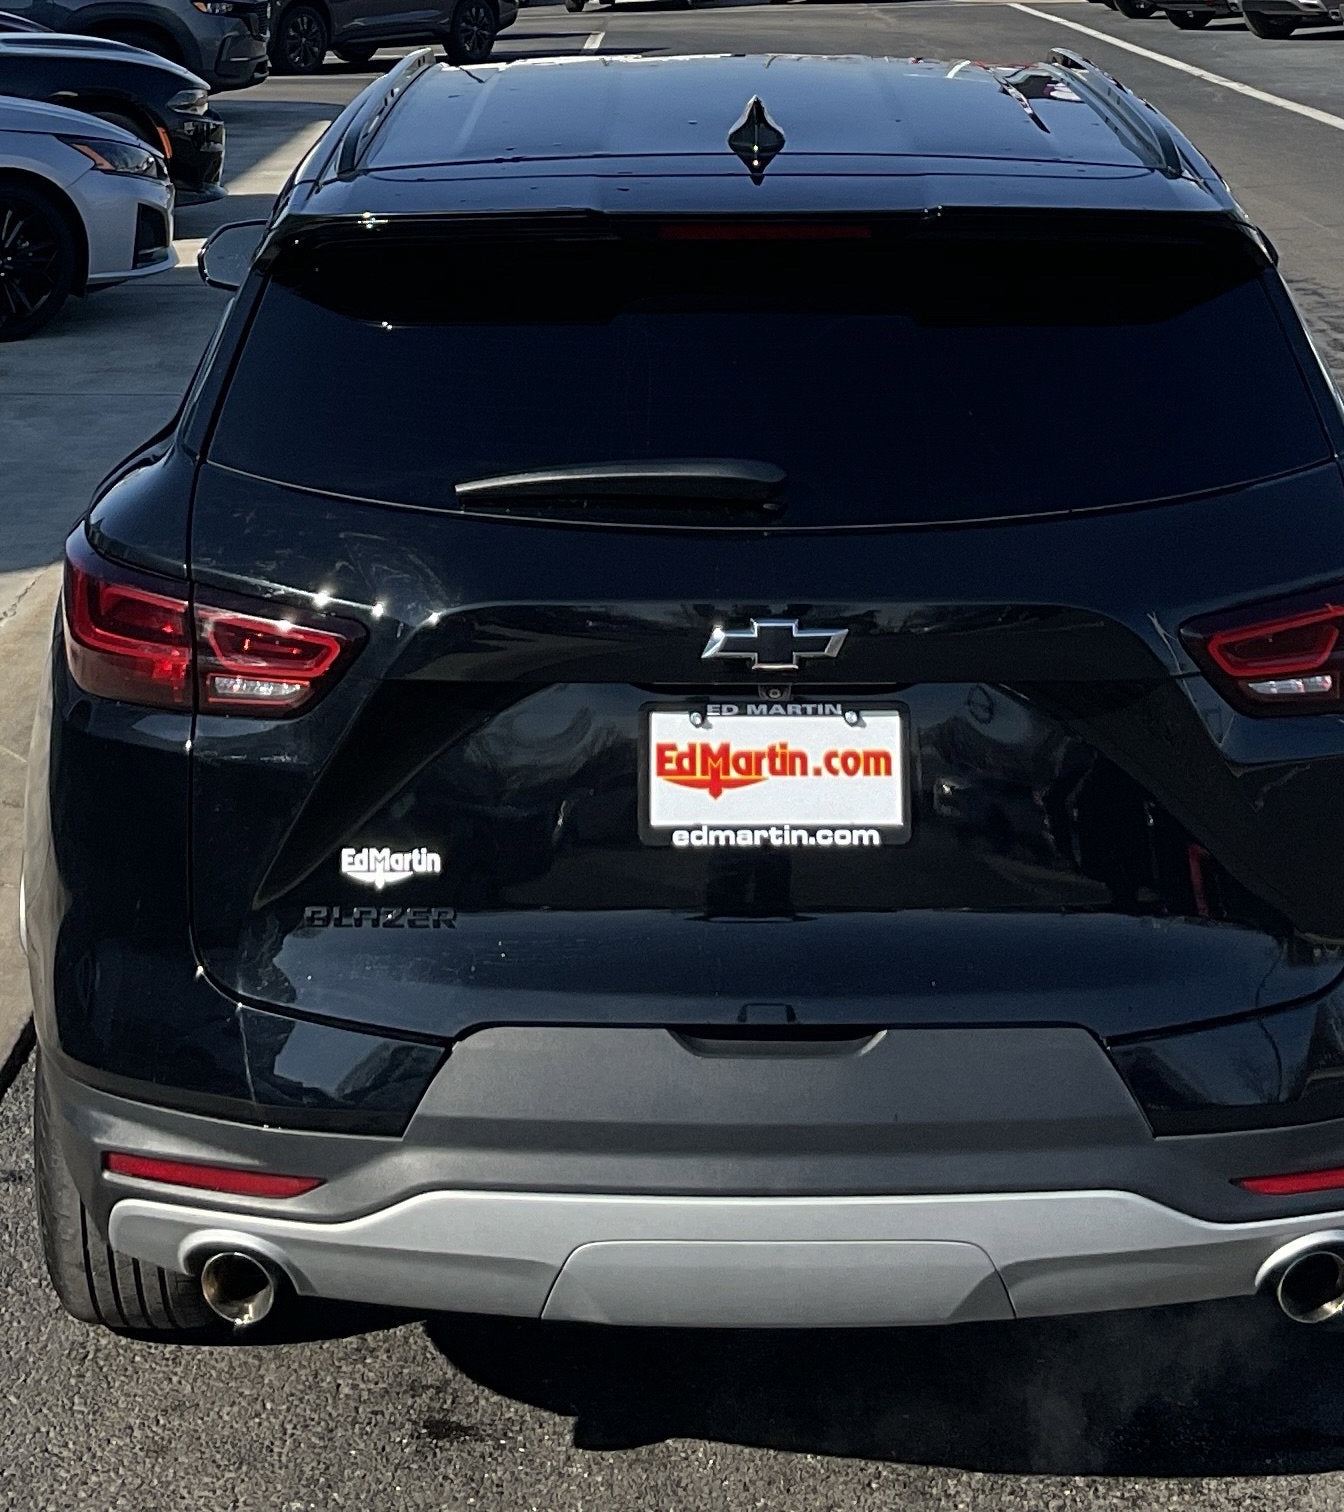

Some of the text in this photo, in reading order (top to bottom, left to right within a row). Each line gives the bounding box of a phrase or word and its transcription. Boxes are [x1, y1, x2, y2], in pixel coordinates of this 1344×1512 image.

[706, 703, 843, 716] ED MARTIN
[656, 742, 894, 782] EdMartin.com
[671, 824, 881, 847] edmartin.com
[341, 847, 442, 876] EdMartin
[304, 905, 458, 929] BLAZER
